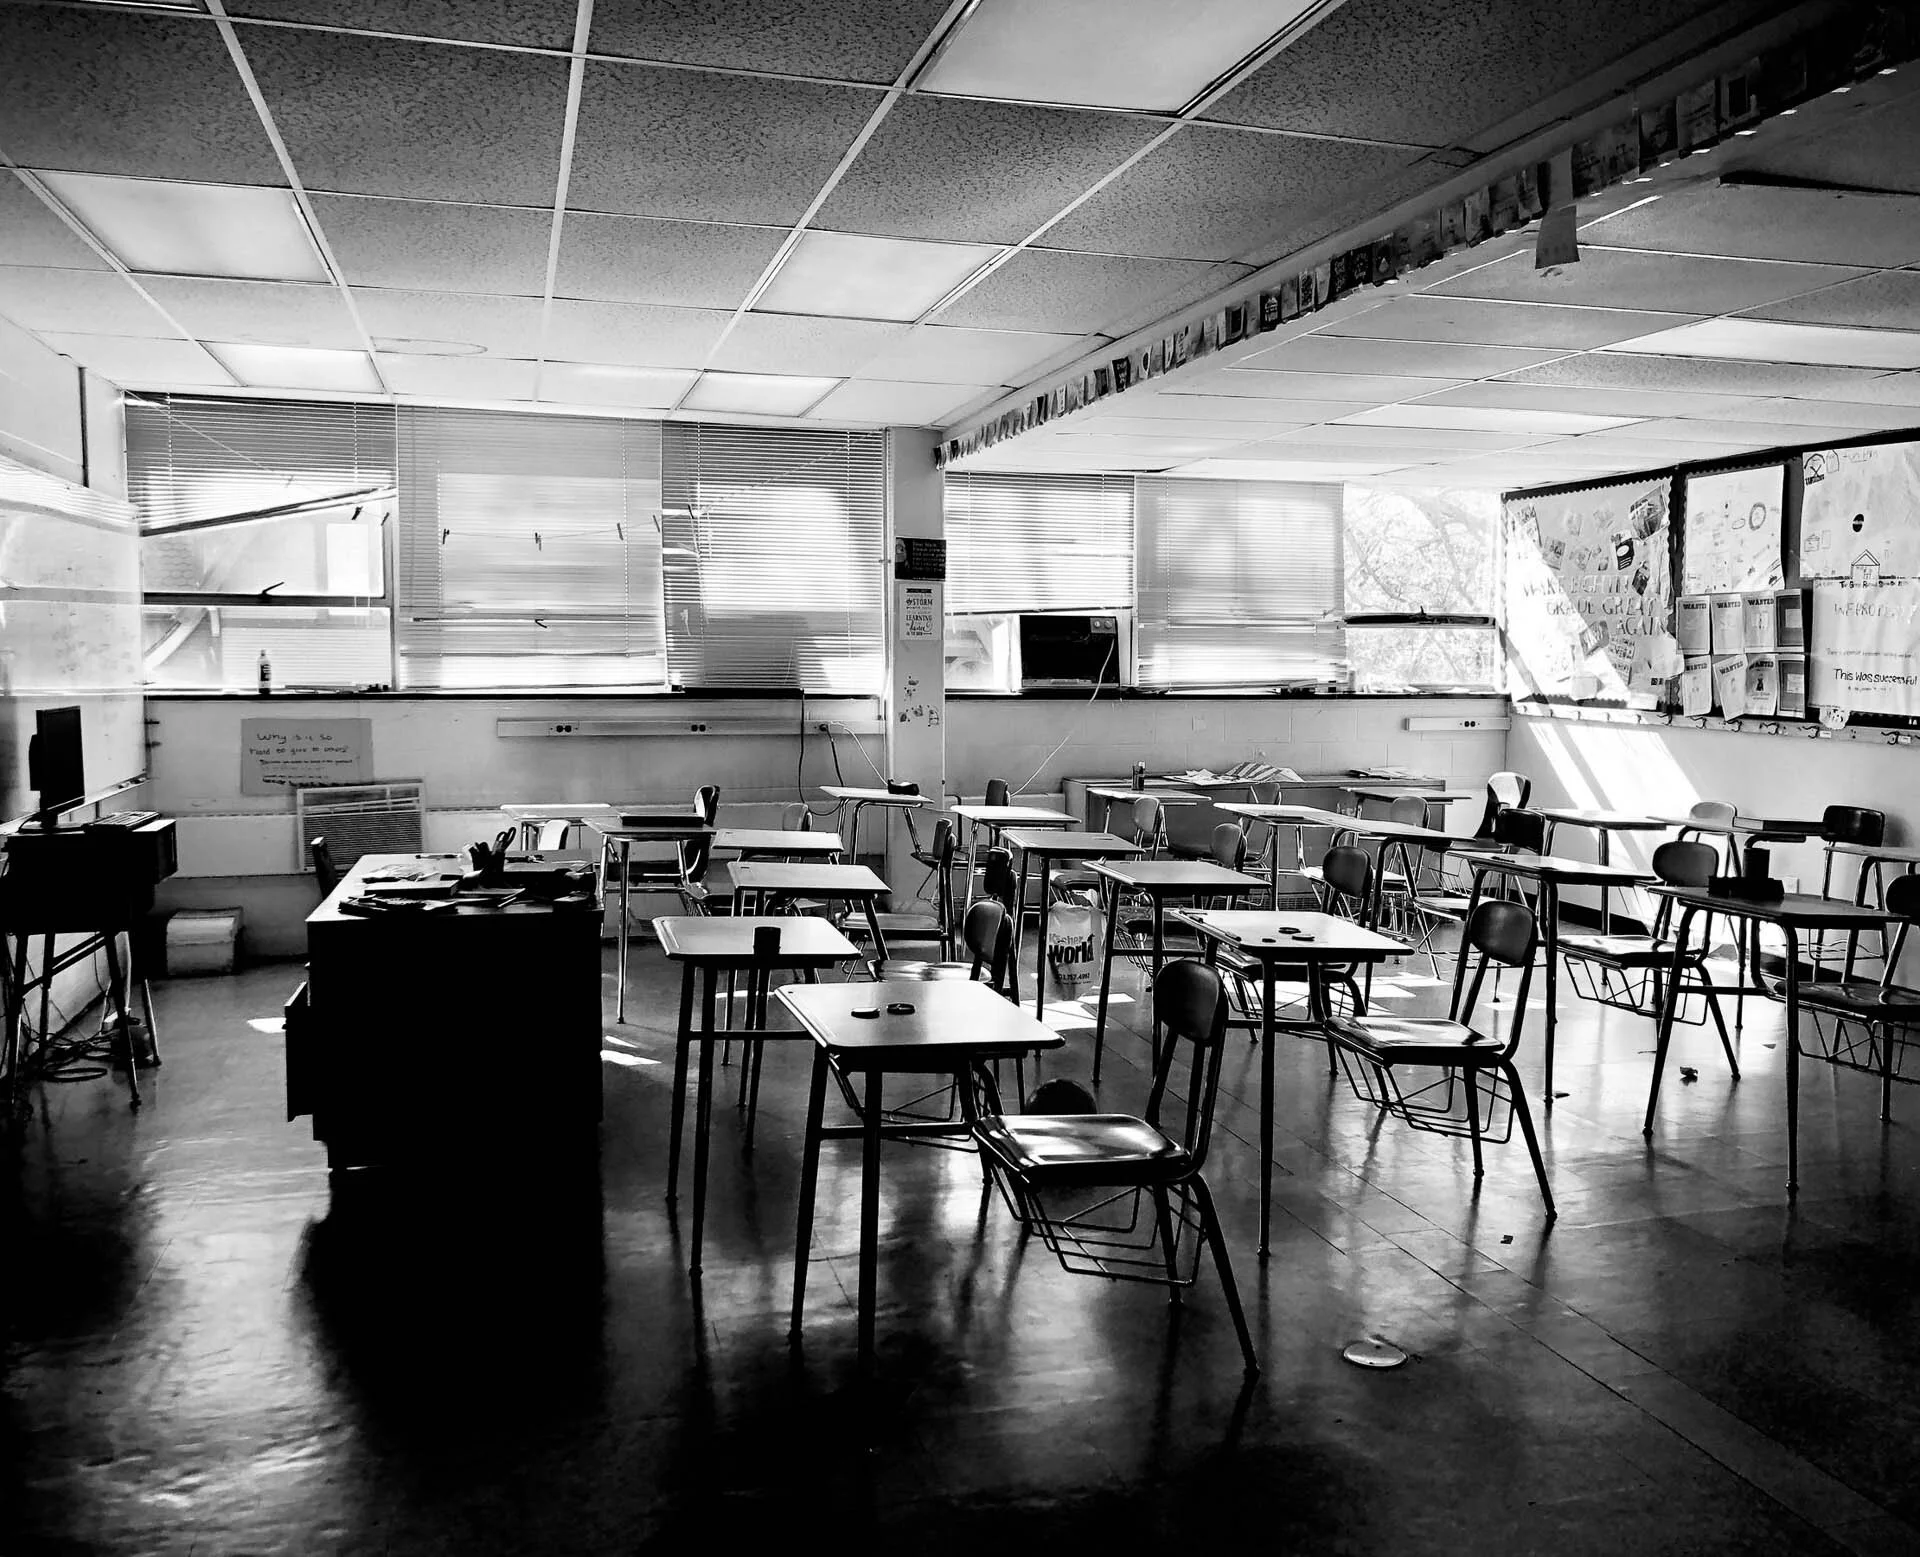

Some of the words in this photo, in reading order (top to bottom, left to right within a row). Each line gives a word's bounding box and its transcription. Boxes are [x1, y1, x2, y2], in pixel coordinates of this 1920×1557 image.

[1748, 598, 1775, 606] WANTED
[1833, 668, 1853, 681] This
[256, 733, 287, 744] Why
